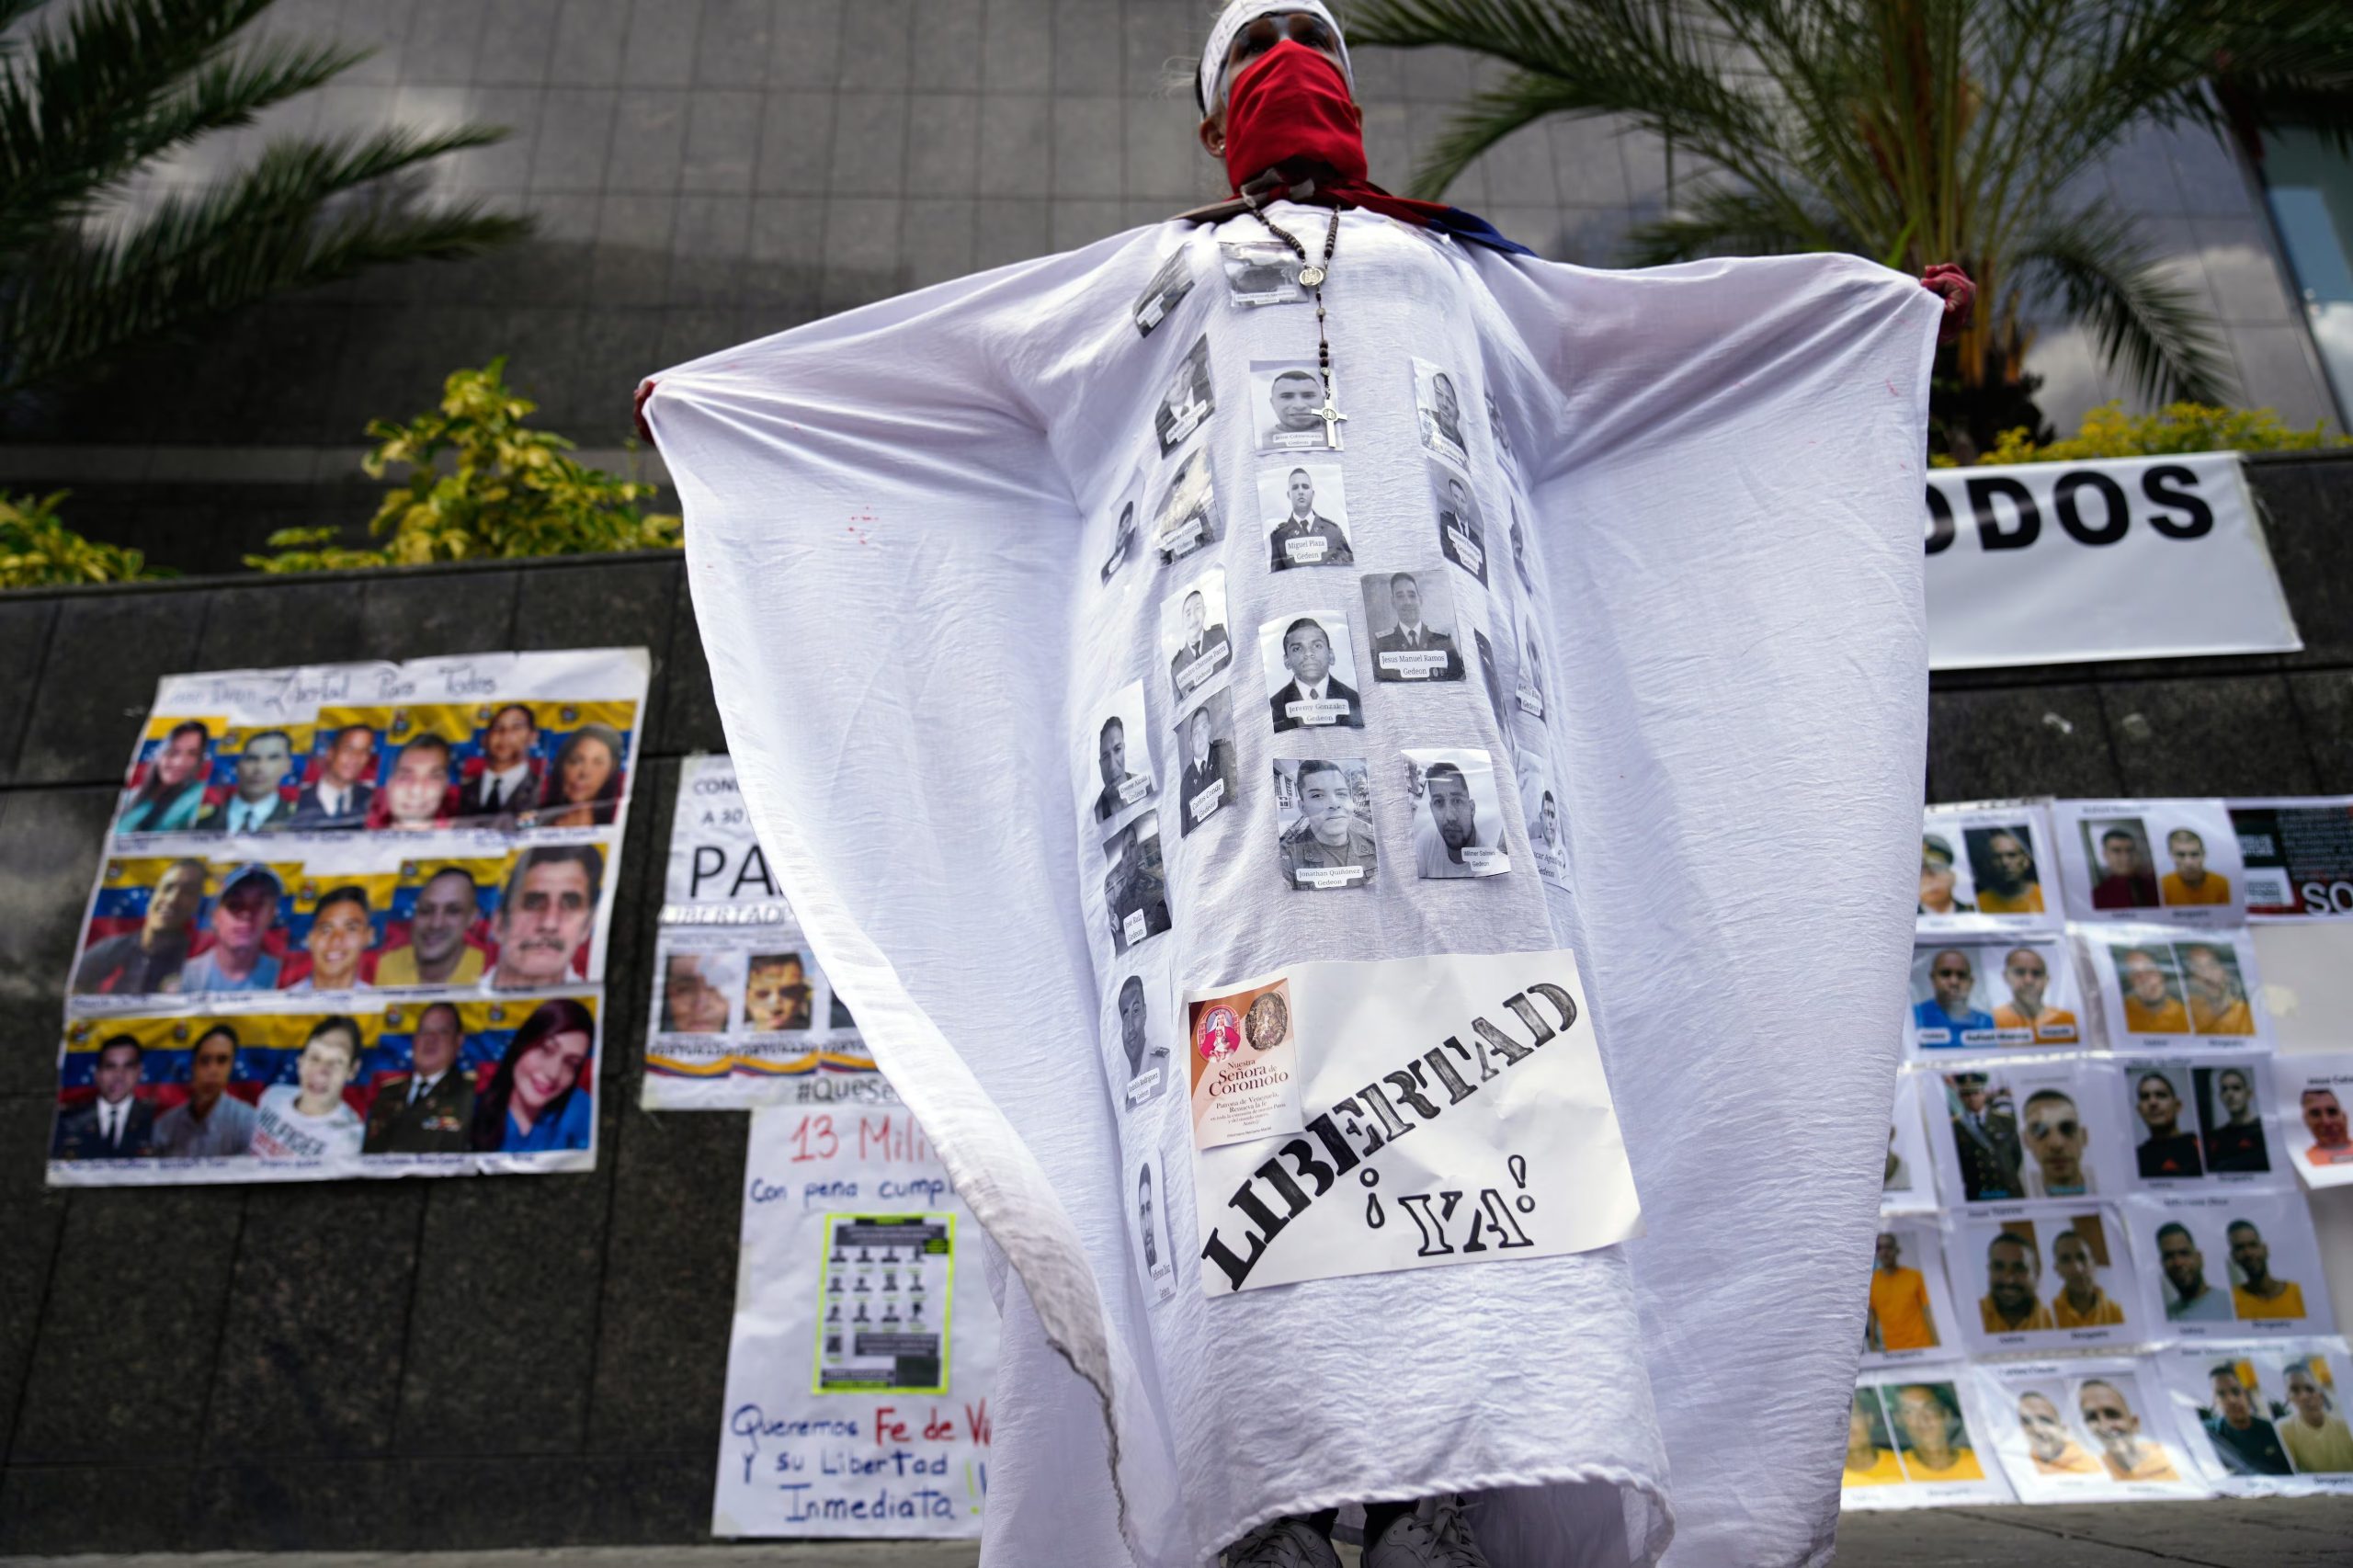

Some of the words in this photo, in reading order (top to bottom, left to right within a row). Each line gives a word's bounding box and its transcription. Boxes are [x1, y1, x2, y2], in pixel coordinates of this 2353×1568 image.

[1288, 541, 1308, 551] Miguel
[1381, 655, 1397, 665] Jesus
[1403, 667, 1427, 676] Gedeon
[1290, 704, 1313, 713] Jeremy
[1315, 702, 1346, 710] Gonzalez
[1192, 796, 1206, 810] Carlos
[1206, 784, 1222, 798] Conde
[1199, 801, 1216, 817] Gedeon
[690, 844, 782, 897] PA
[1128, 929, 1143, 941] Gedeon
[1218, 1065, 1267, 1085] Señora
[1267, 1064, 1277, 1073] de
[1228, 1059, 1256, 1070] Nuestra
[1209, 1071, 1289, 1096] Coromoto
[1216, 1099, 1239, 1109] Patrona
[790, 1114, 839, 1163] 13
[1200, 983, 1578, 1291] LIBERTAD
[750, 1176, 788, 1203] Con
[803, 1180, 858, 1208] pena
[731, 1403, 858, 1451] Queremos
[875, 1406, 911, 1447] Fe
[923, 1405, 956, 1441] de
[776, 1450, 805, 1472] su
[820, 1449, 948, 1476] Libertad
[778, 1483, 957, 1523] Inmediata
